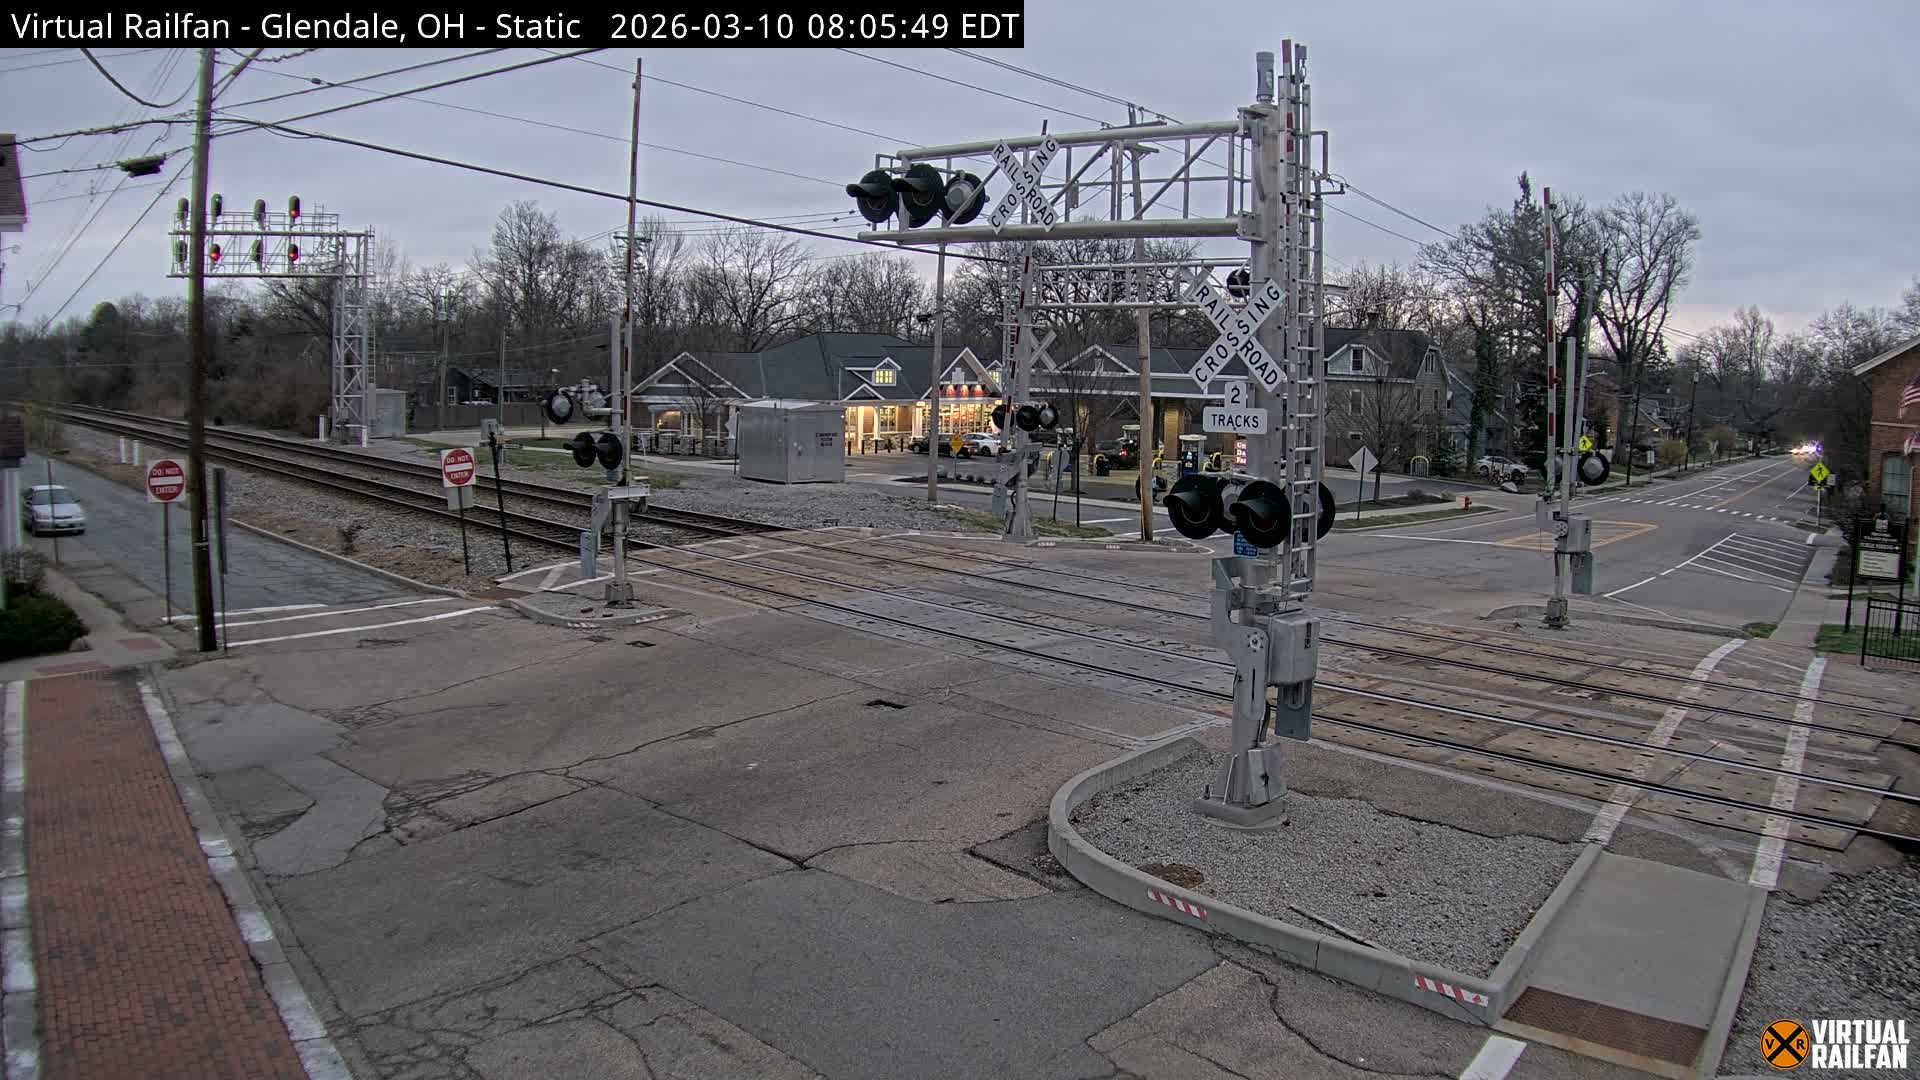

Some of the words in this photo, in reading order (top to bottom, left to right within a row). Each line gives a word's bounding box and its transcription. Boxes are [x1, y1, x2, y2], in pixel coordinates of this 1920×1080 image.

[991, 140, 1056, 228] CROSSING
[1195, 286, 1280, 383] CROSSING
[1211, 414, 1259, 428] TRACKS
[1231, 387, 1241, 404] 2
